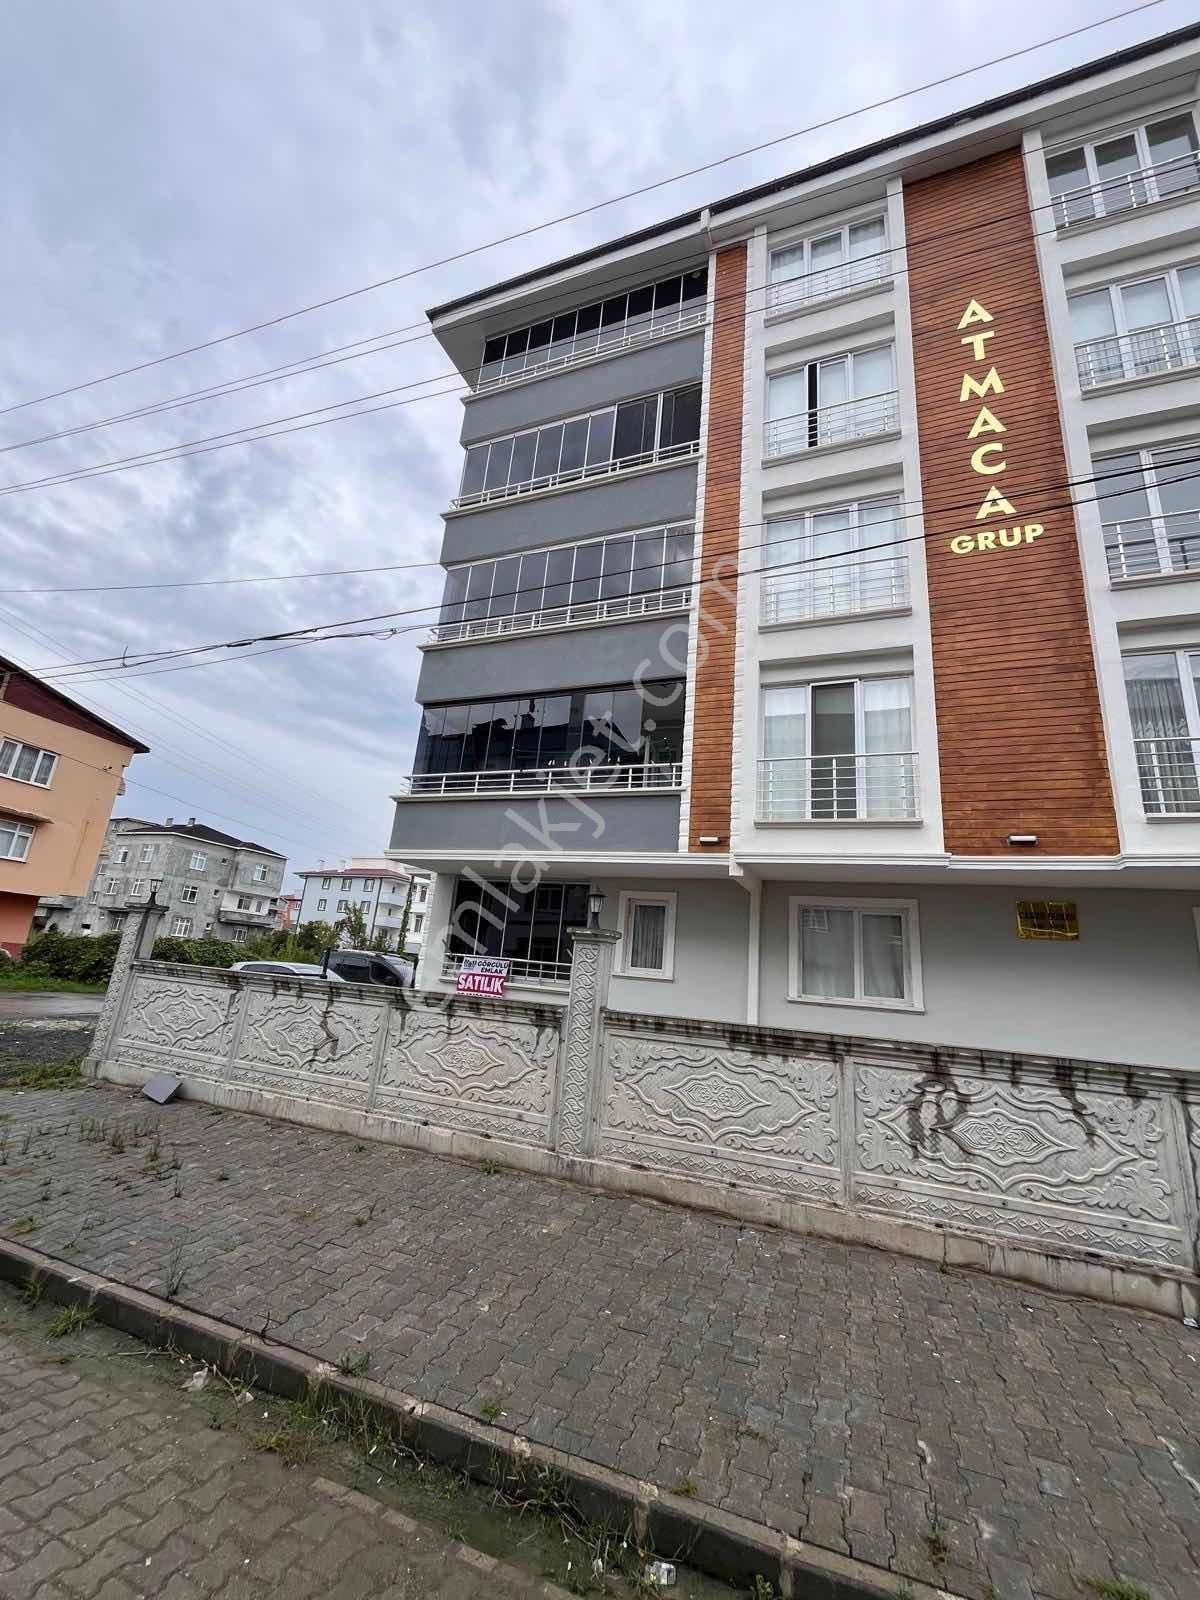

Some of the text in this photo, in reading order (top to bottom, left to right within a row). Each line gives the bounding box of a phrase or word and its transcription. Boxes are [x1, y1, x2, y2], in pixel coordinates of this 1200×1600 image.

[957, 299, 1017, 520] ATMACA
[950, 523, 1044, 554] GRUP
[458, 974, 505, 993] SATILIK
[480, 967, 504, 975] EMLAK
